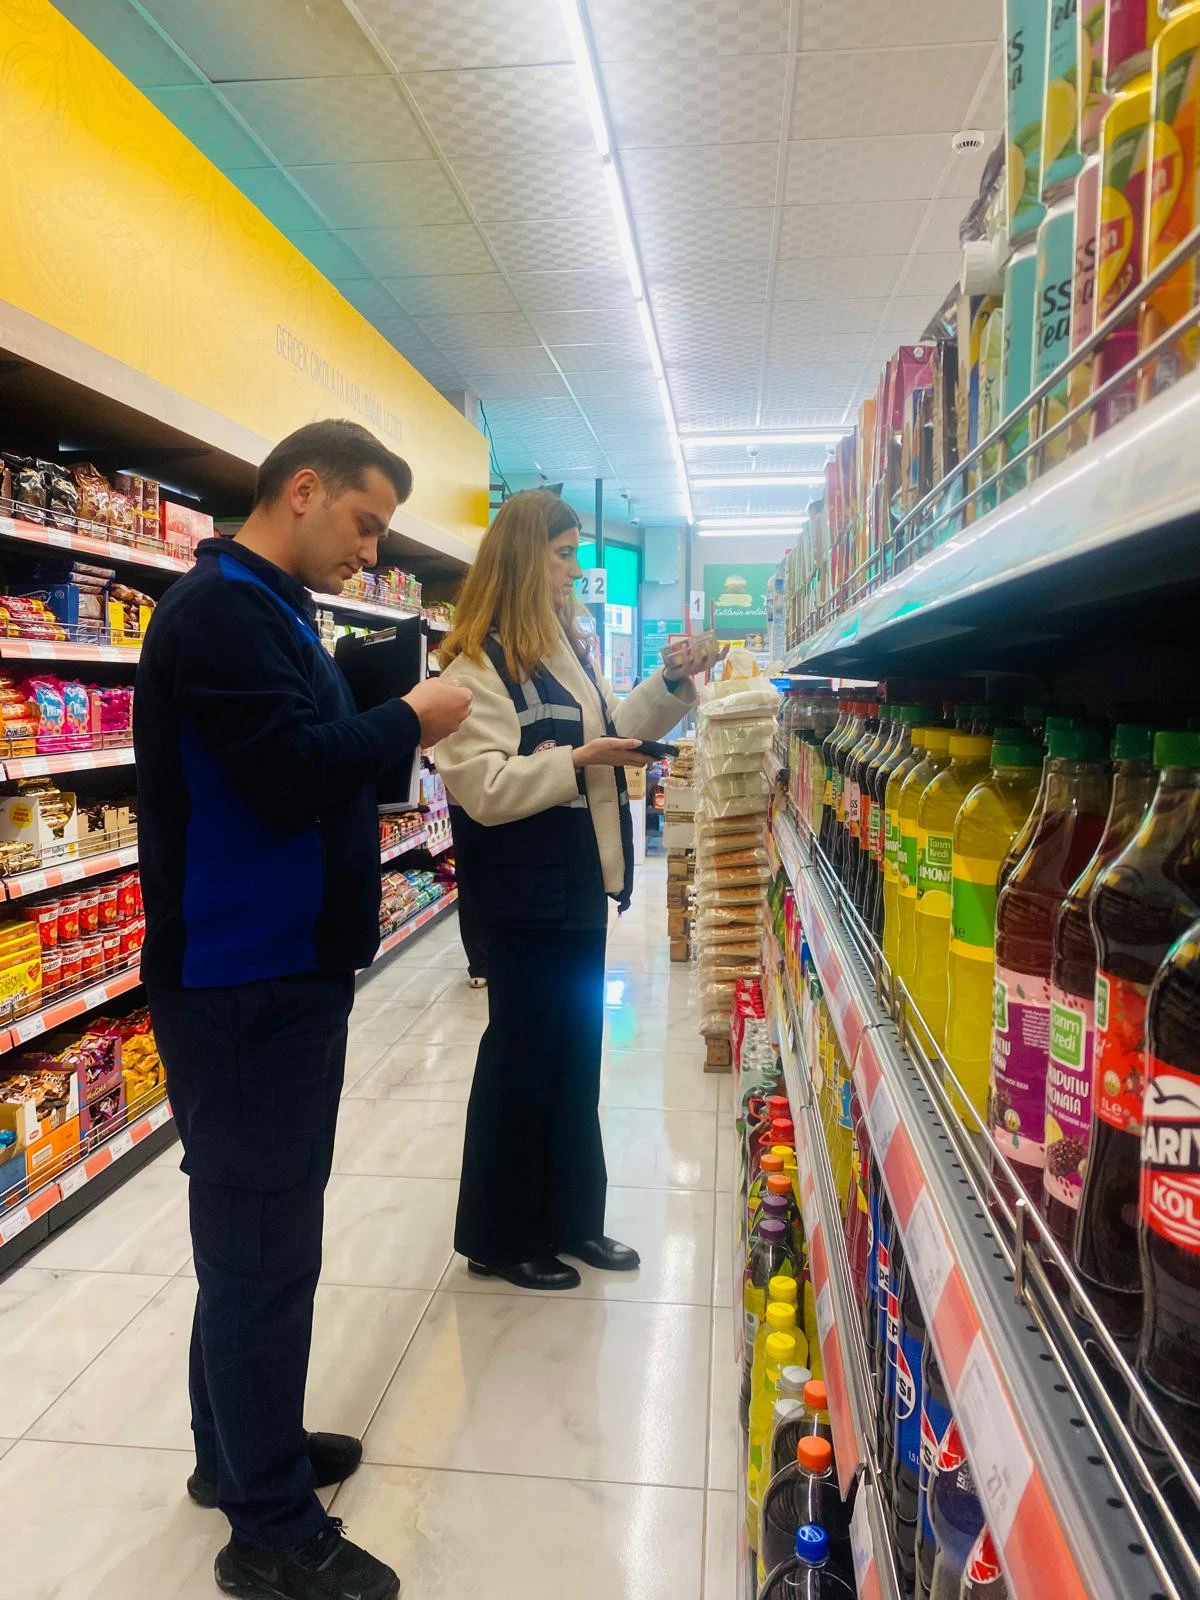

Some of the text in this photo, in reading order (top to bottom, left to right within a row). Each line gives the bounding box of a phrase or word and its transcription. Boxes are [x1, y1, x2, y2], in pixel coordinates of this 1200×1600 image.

[276, 323, 308, 377] GERÇEK
[581, 577, 604, 594] 2 2
[694, 598, 700, 612] 1
[929, 848, 949, 858] Kredi
